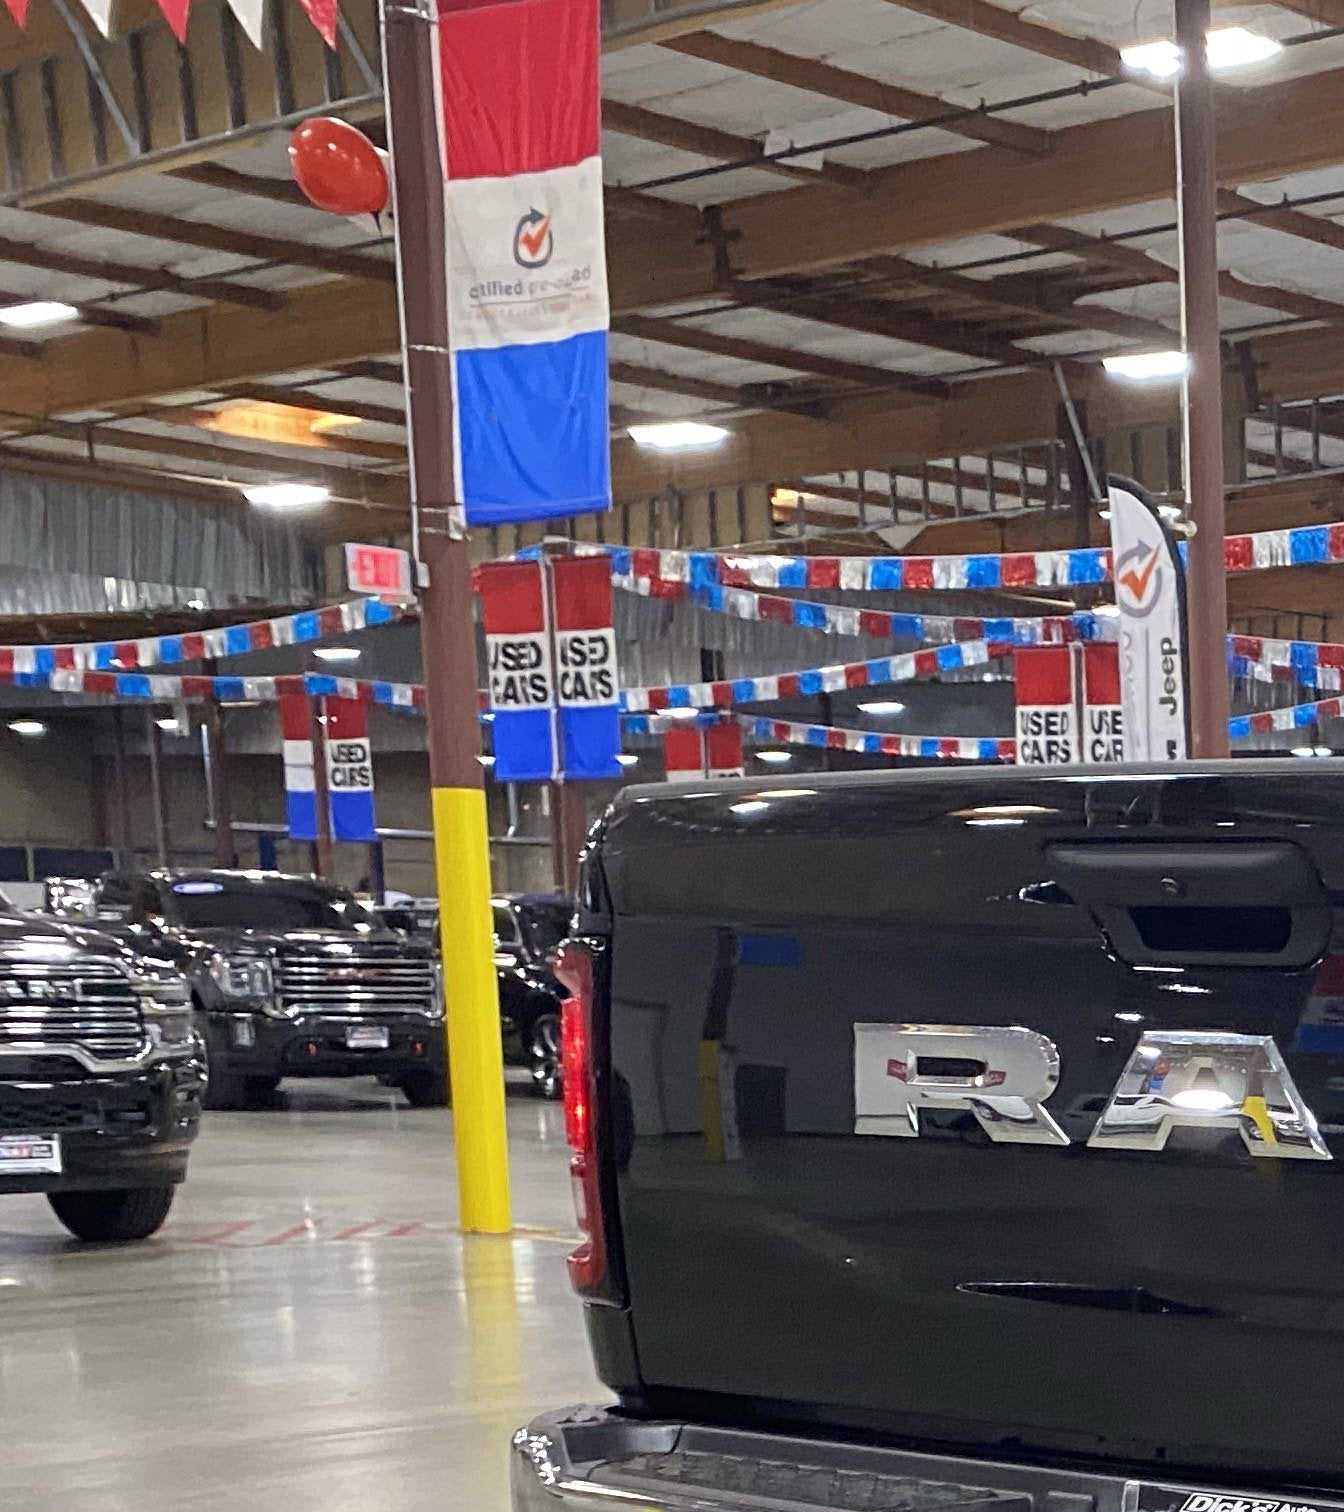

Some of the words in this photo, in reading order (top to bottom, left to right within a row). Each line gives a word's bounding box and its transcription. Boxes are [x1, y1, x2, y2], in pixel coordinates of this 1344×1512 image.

[469, 280, 523, 299] ctified
[1159, 637, 1178, 716] Jeep
[1021, 711, 1070, 736] USED
[1091, 710, 1123, 735] USE
[1020, 739, 1071, 763] CARS
[1091, 739, 1124, 762] CAR
